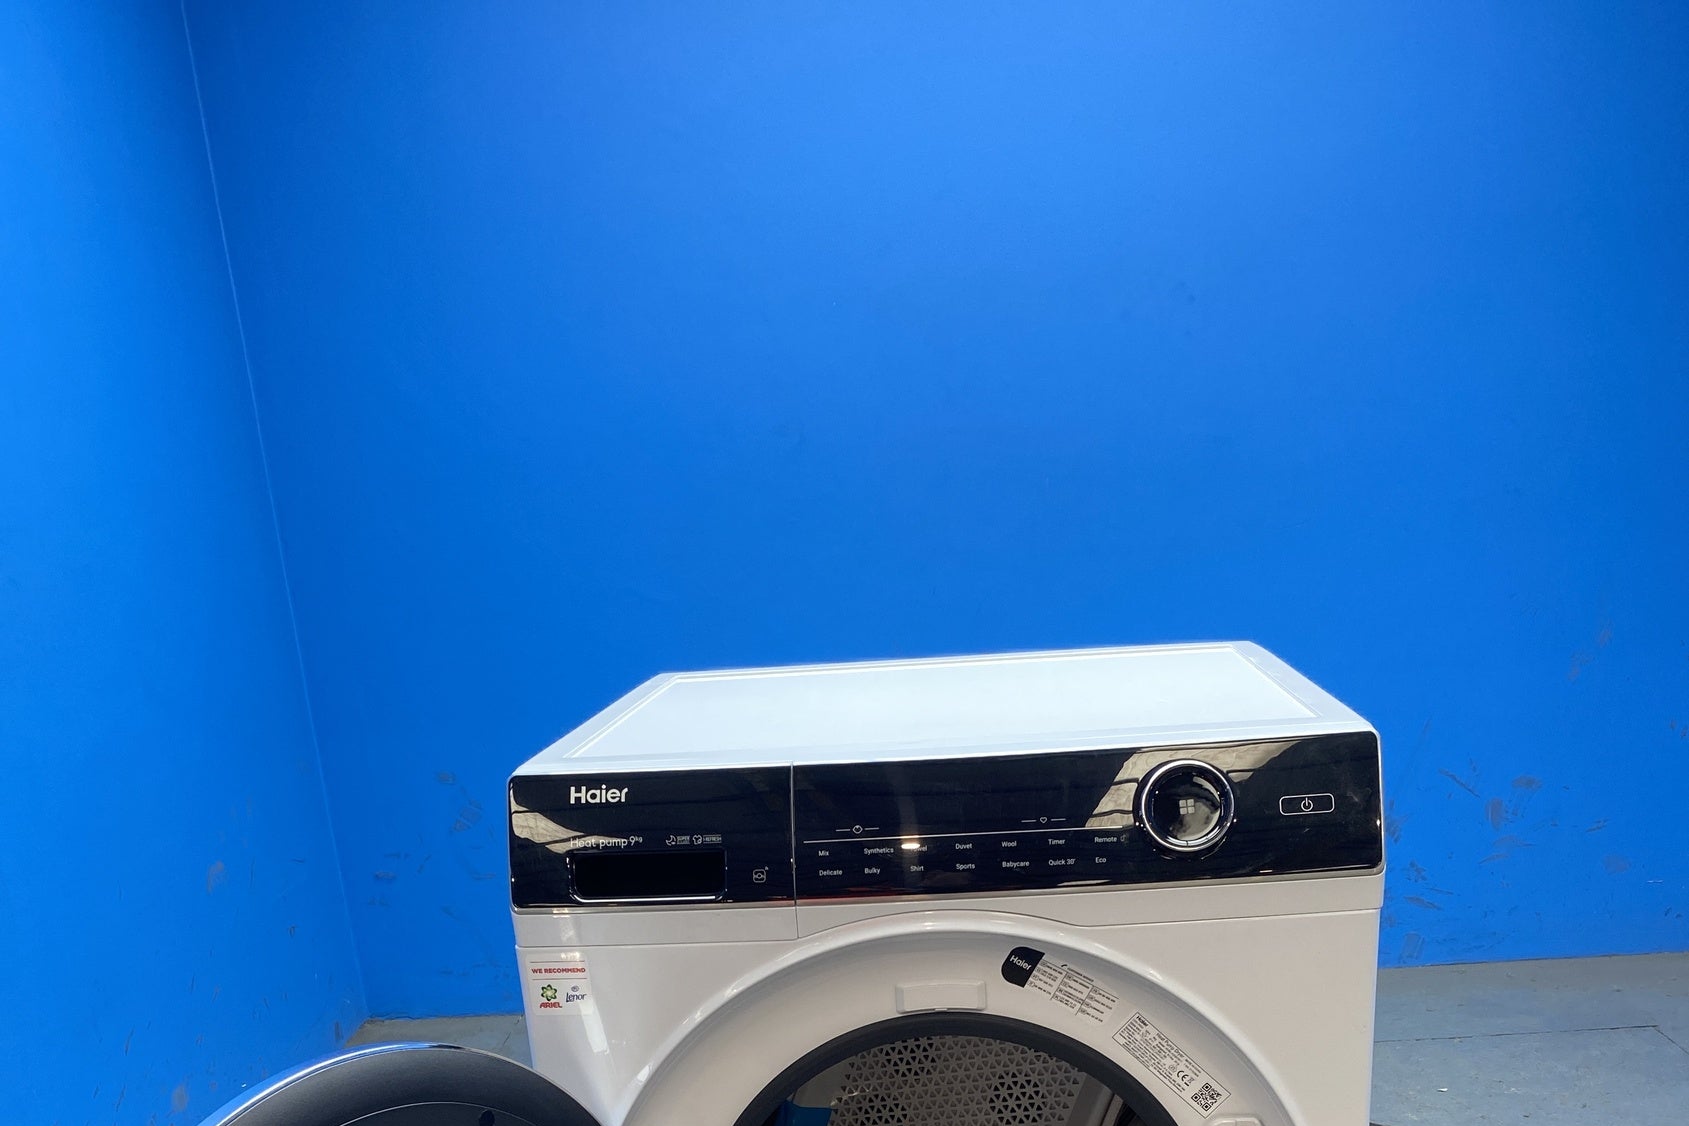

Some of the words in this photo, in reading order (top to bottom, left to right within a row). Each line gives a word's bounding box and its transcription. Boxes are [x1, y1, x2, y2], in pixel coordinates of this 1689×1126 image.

[570, 784, 628, 804] Haier
[570, 837, 596, 848] Heat
[599, 838, 628, 849] pump
[863, 847, 894, 855] Synthetics
[955, 863, 975, 871] Sports
[1002, 861, 1030, 869] Babycare
[864, 867, 880, 875] Bulky
[1009, 954, 1032, 971] Haier
[565, 992, 587, 1003] Lenor
[539, 1001, 563, 1009] ARIEL
[1135, 1015, 1149, 1027] Haier
